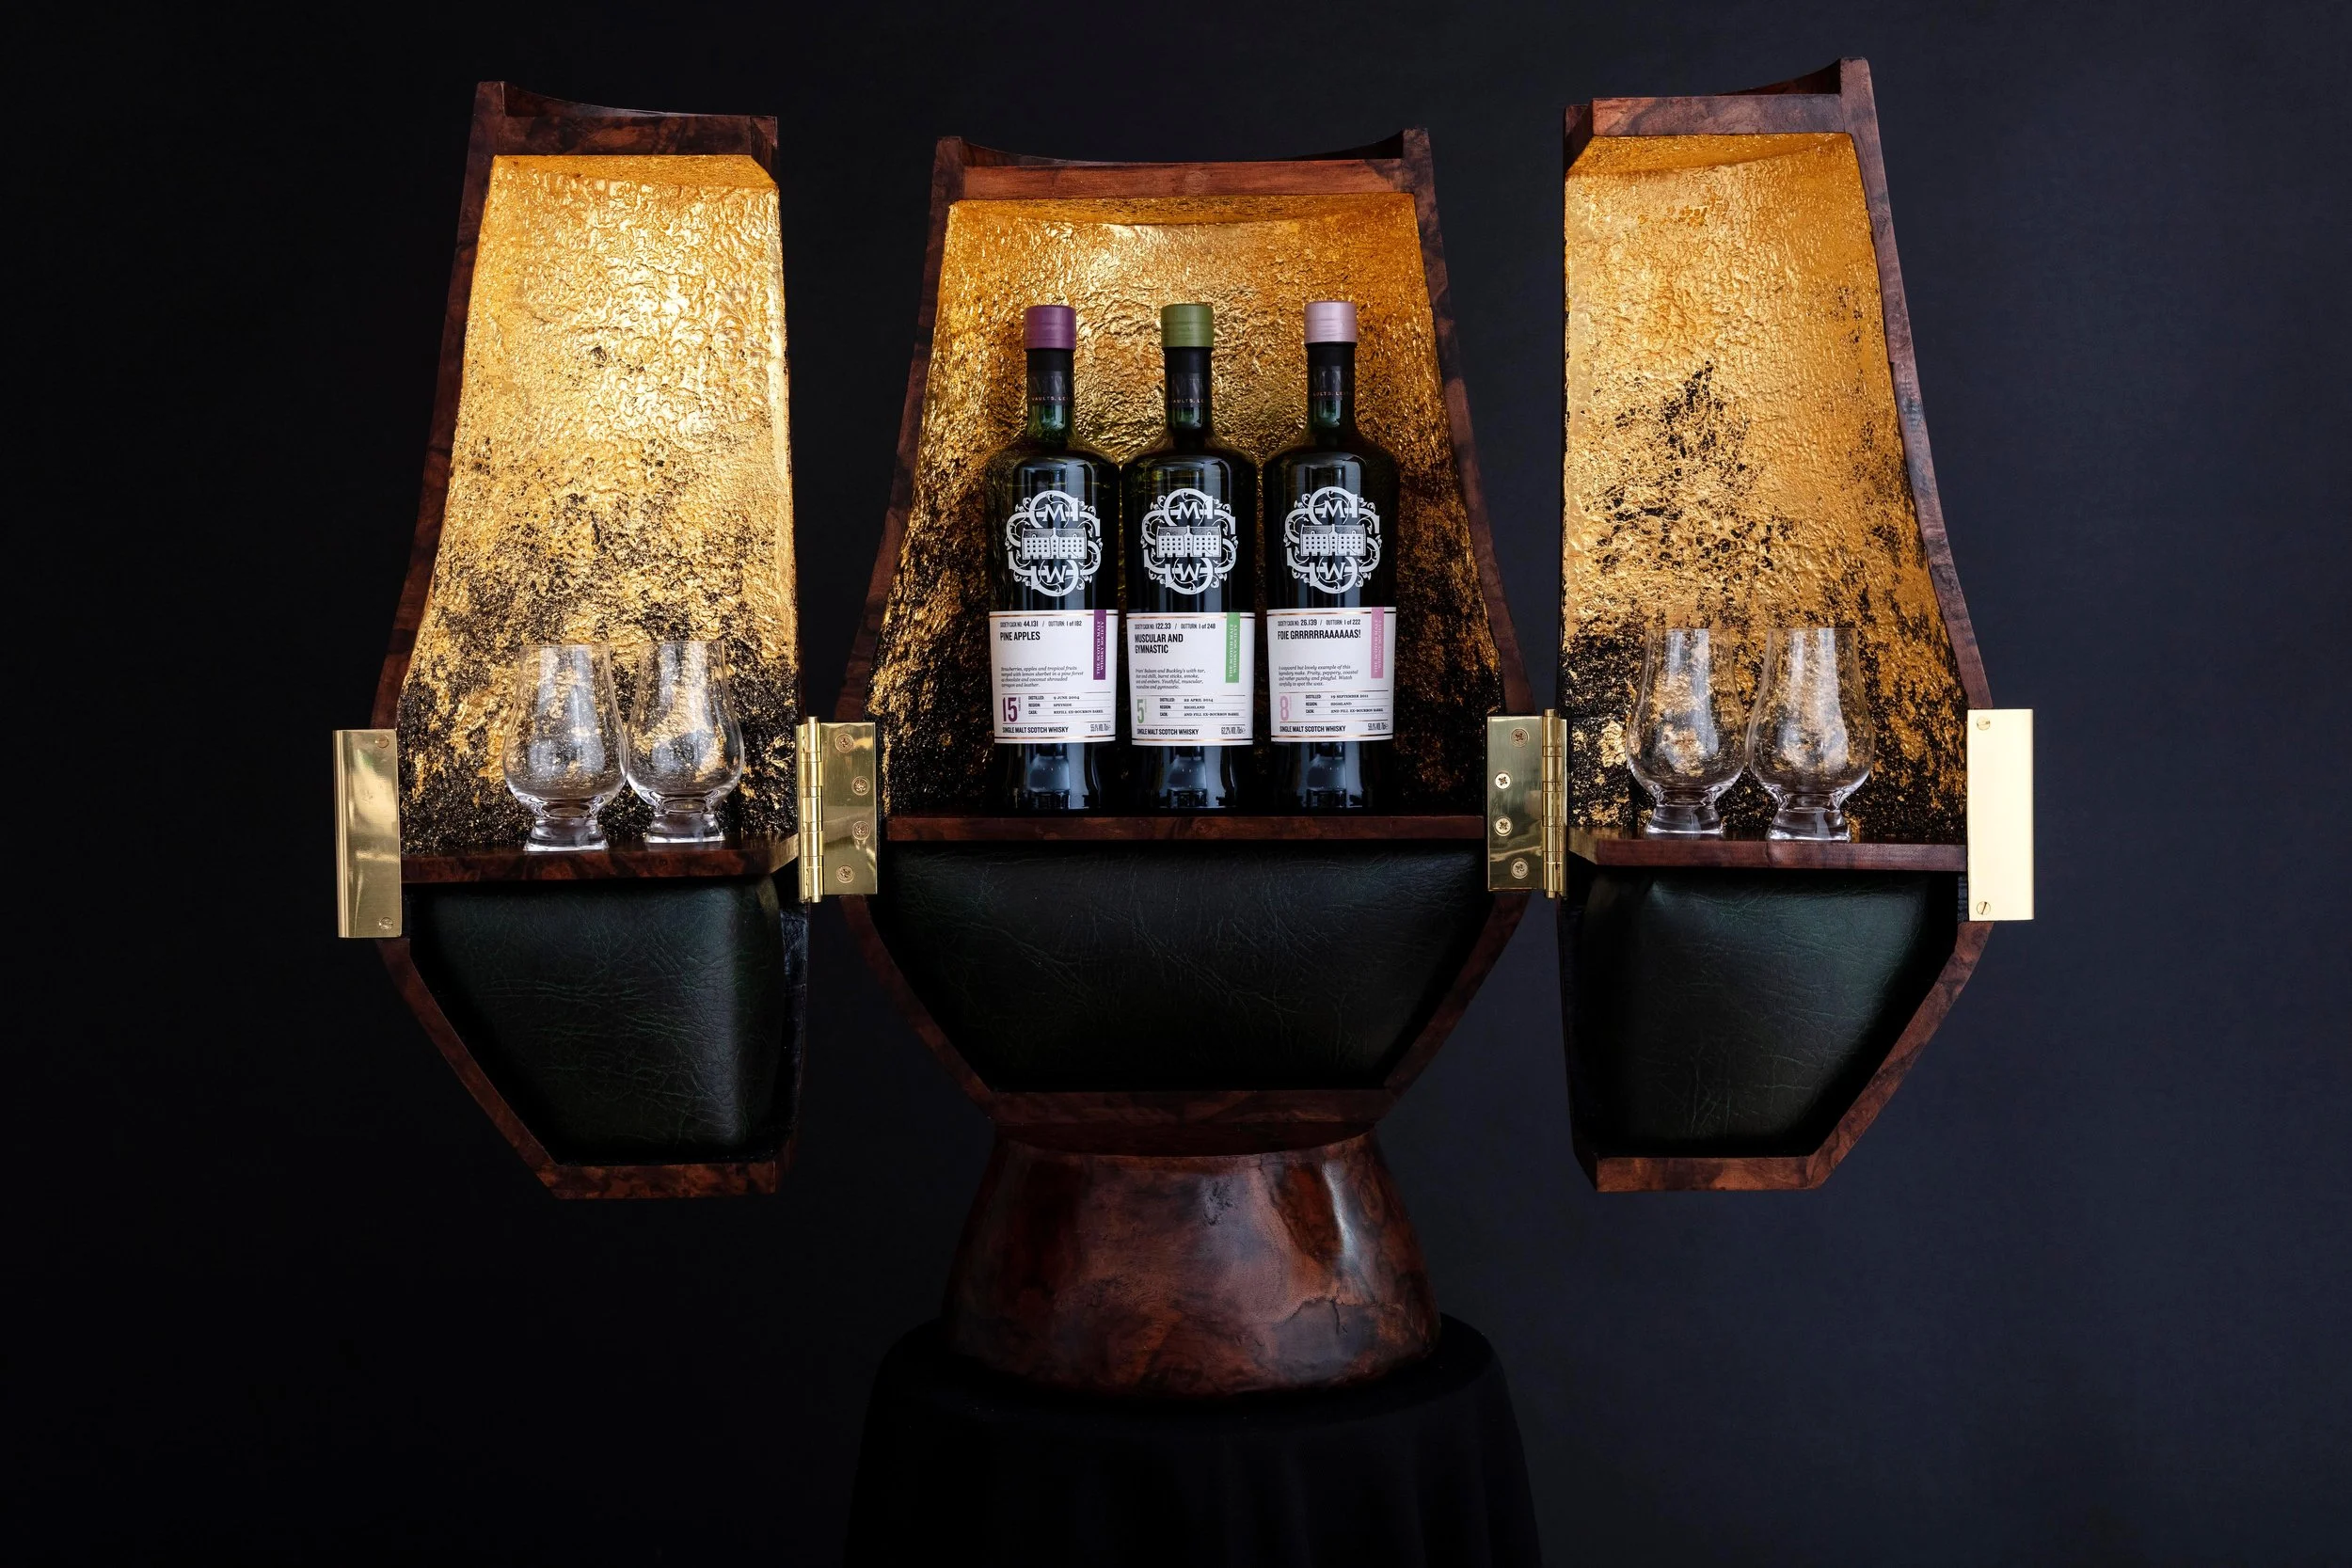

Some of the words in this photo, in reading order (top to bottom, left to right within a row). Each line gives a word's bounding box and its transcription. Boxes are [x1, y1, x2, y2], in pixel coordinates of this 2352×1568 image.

[1000, 631, 1012, 641] PINE
[1014, 631, 1040, 641] APPLES
[1135, 634, 1166, 642] MUSCULAR
[1168, 634, 1184, 642] AND
[1278, 630, 1289, 640] FOIE
[1136, 644, 1168, 654] GYMNASTIC
[1003, 697, 1017, 721] 15
[1137, 699, 1144, 723] 5
[1280, 696, 1289, 721] 8
